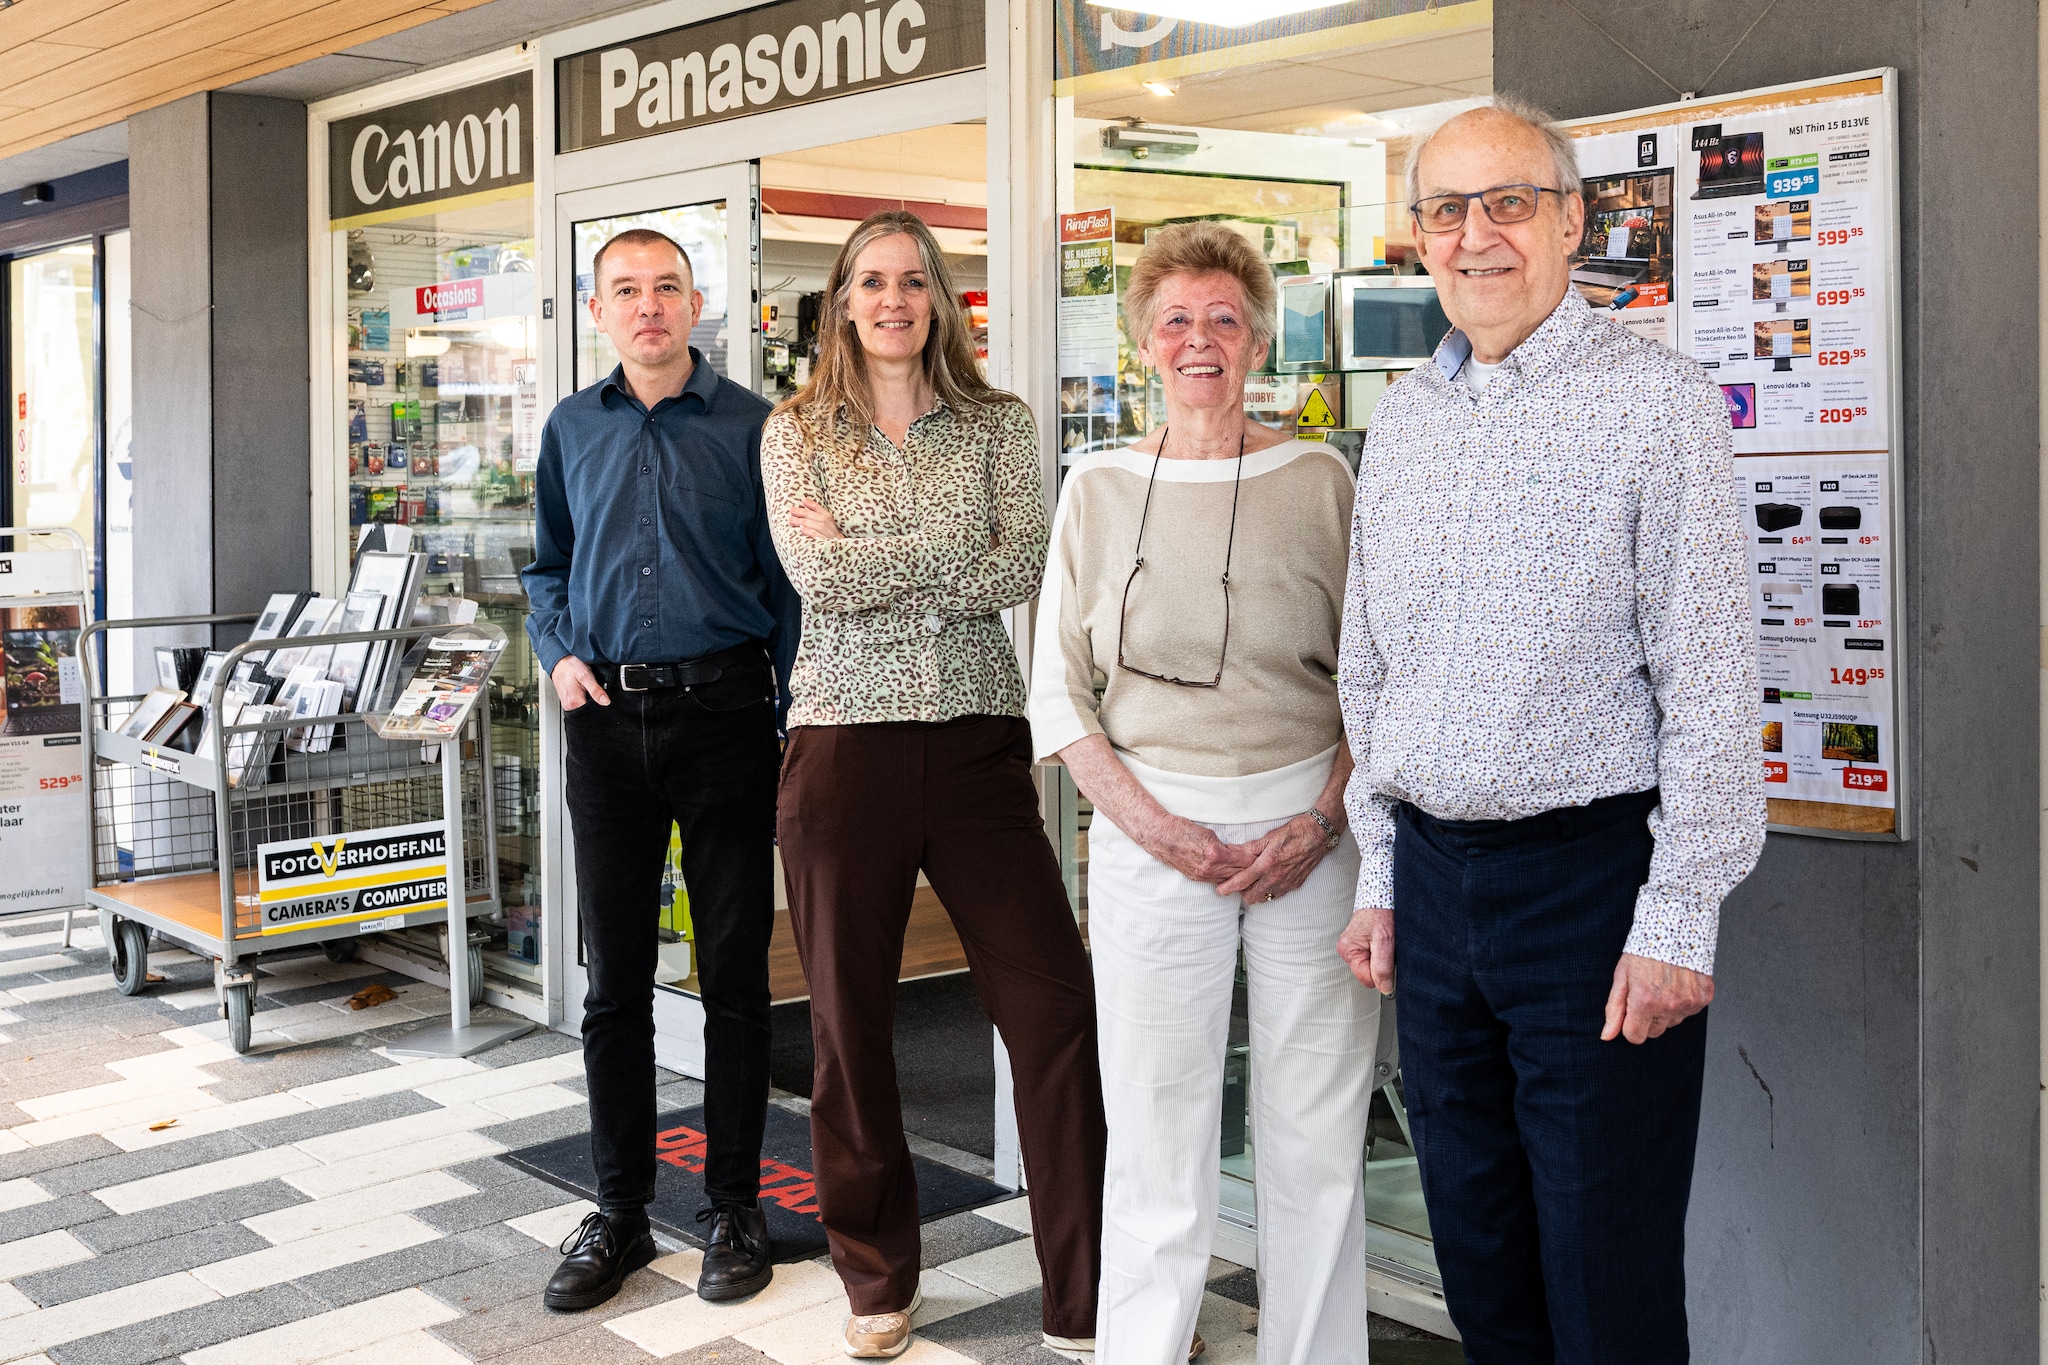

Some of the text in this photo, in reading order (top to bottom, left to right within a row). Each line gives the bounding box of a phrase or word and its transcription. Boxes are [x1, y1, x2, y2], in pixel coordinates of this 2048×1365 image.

[601, 0, 927, 137] Panasonic
[1789, 117, 1870, 136] MSI Thin 15 B13VE
[1694, 137, 1720, 148] 144 Hz
[351, 103, 520, 205] Canon
[1790, 157, 1804, 165] RTX
[1804, 156, 1817, 164] 4050
[1773, 174, 1814, 193] 939,95
[1708, 210, 1737, 218] All-in-One
[1065, 214, 1109, 232] RingFlash
[1817, 227, 1863, 246] 599,95
[1708, 268, 1737, 276] All-in-One
[424, 283, 477, 310] Occasions
[1816, 288, 1865, 306] 699,95
[544, 302, 552, 316] 12
[1716, 325, 1744, 333] All-in-One
[1817, 348, 1866, 366] 629,95
[1244, 392, 1276, 403] OODBYE
[1819, 407, 1867, 423] 209,95
[1791, 536, 1811, 545] 64,95
[1858, 535, 1879, 545] 49,95
[1759, 634, 1784, 643] Samsung
[1830, 667, 1884, 686] 149,95
[1793, 711, 1820, 720] Samsung
[39, 774, 83, 790] 529,95
[1848, 772, 1883, 786] 219,95
[271, 838, 446, 878] FOTOVERHOEFF.NL
[0, 886, 64, 901] mogelijkheden!
[268, 896, 350, 922] CAMERA'S
